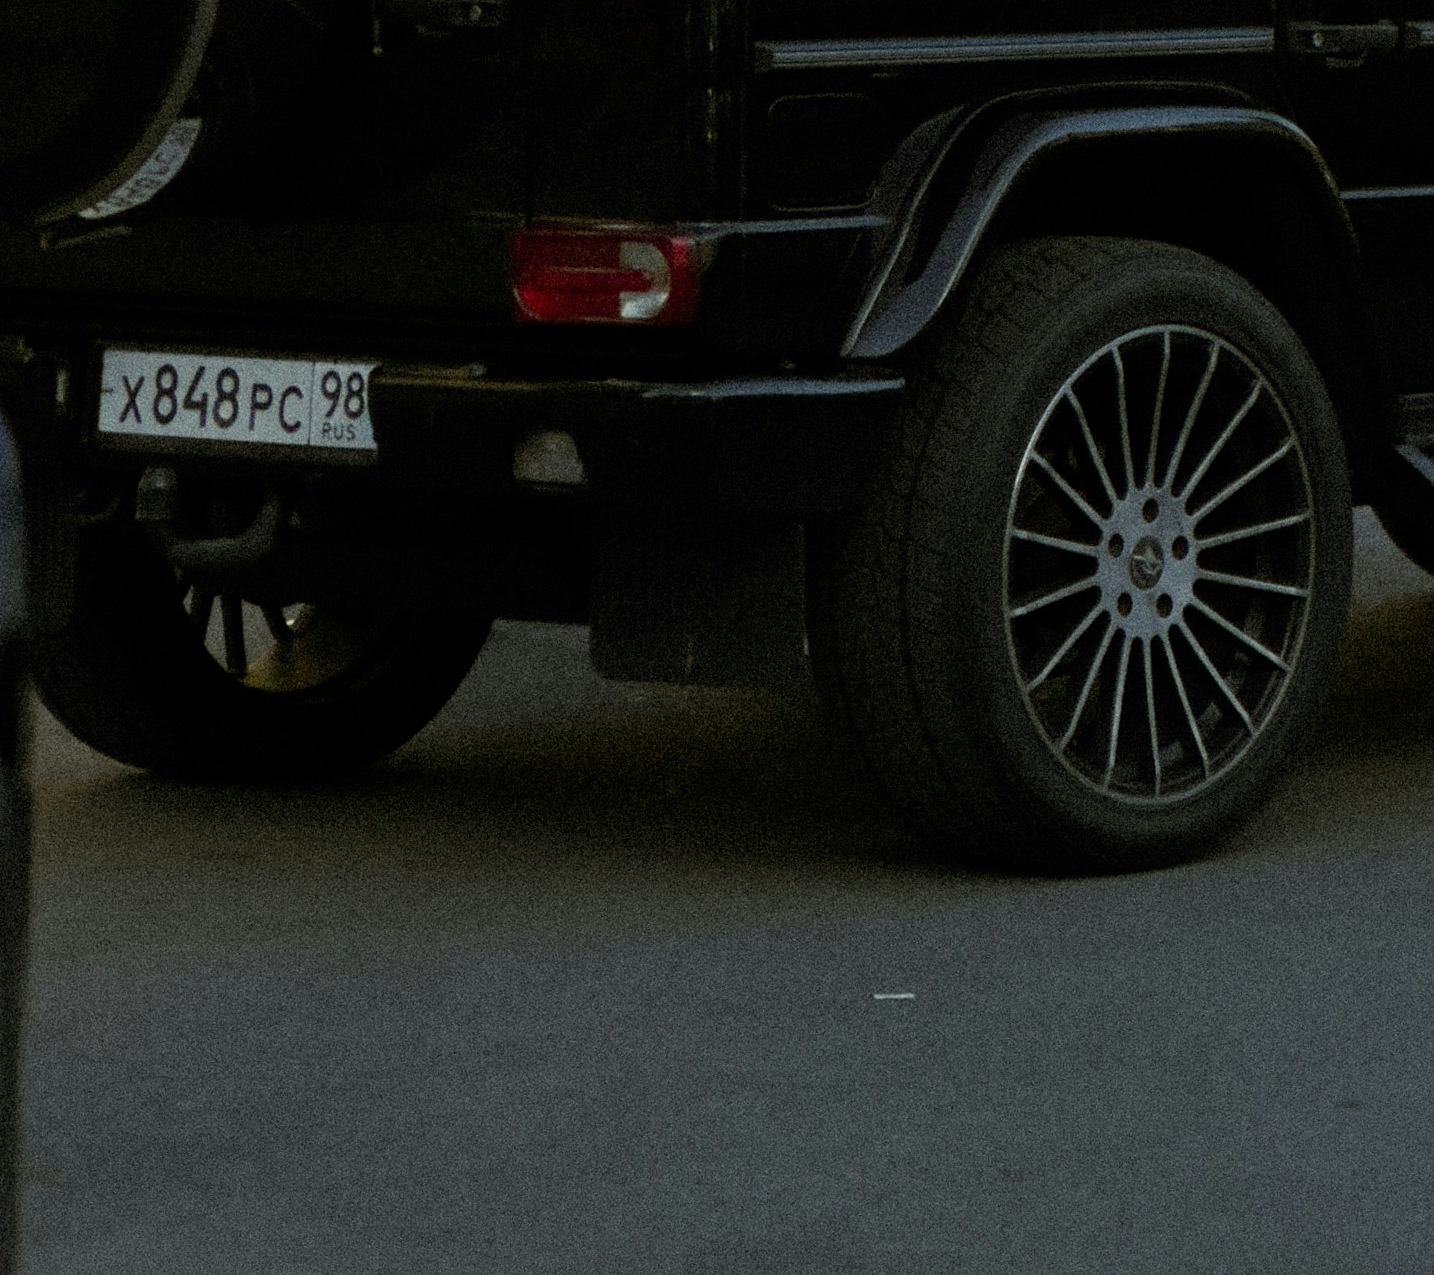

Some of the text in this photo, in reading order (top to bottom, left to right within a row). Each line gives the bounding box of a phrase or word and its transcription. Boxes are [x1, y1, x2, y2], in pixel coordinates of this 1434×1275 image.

[119, 363, 366, 434] X848PC 98
[322, 421, 357, 442] RUS
